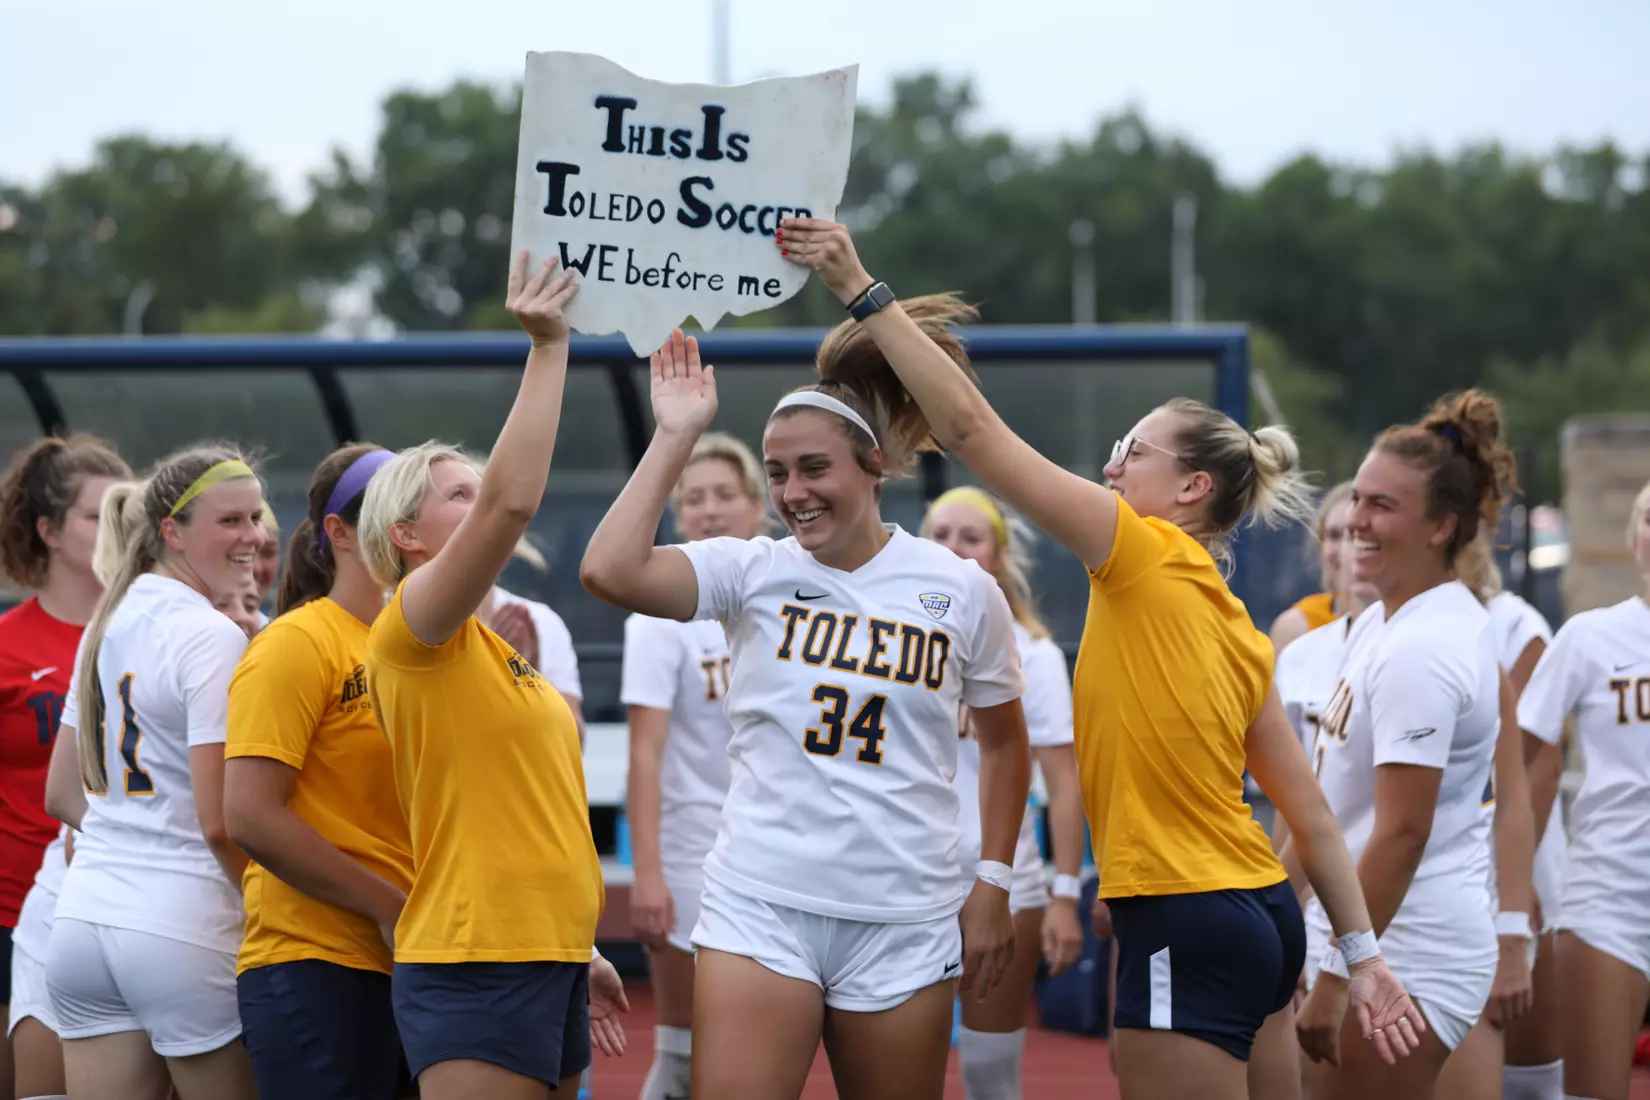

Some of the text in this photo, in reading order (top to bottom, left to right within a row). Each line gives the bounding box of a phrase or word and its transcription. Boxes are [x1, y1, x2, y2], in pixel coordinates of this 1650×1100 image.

[558, 241, 782, 298] WE before me
[777, 604, 949, 691] TOLEDO
[803, 683, 887, 765] 34
